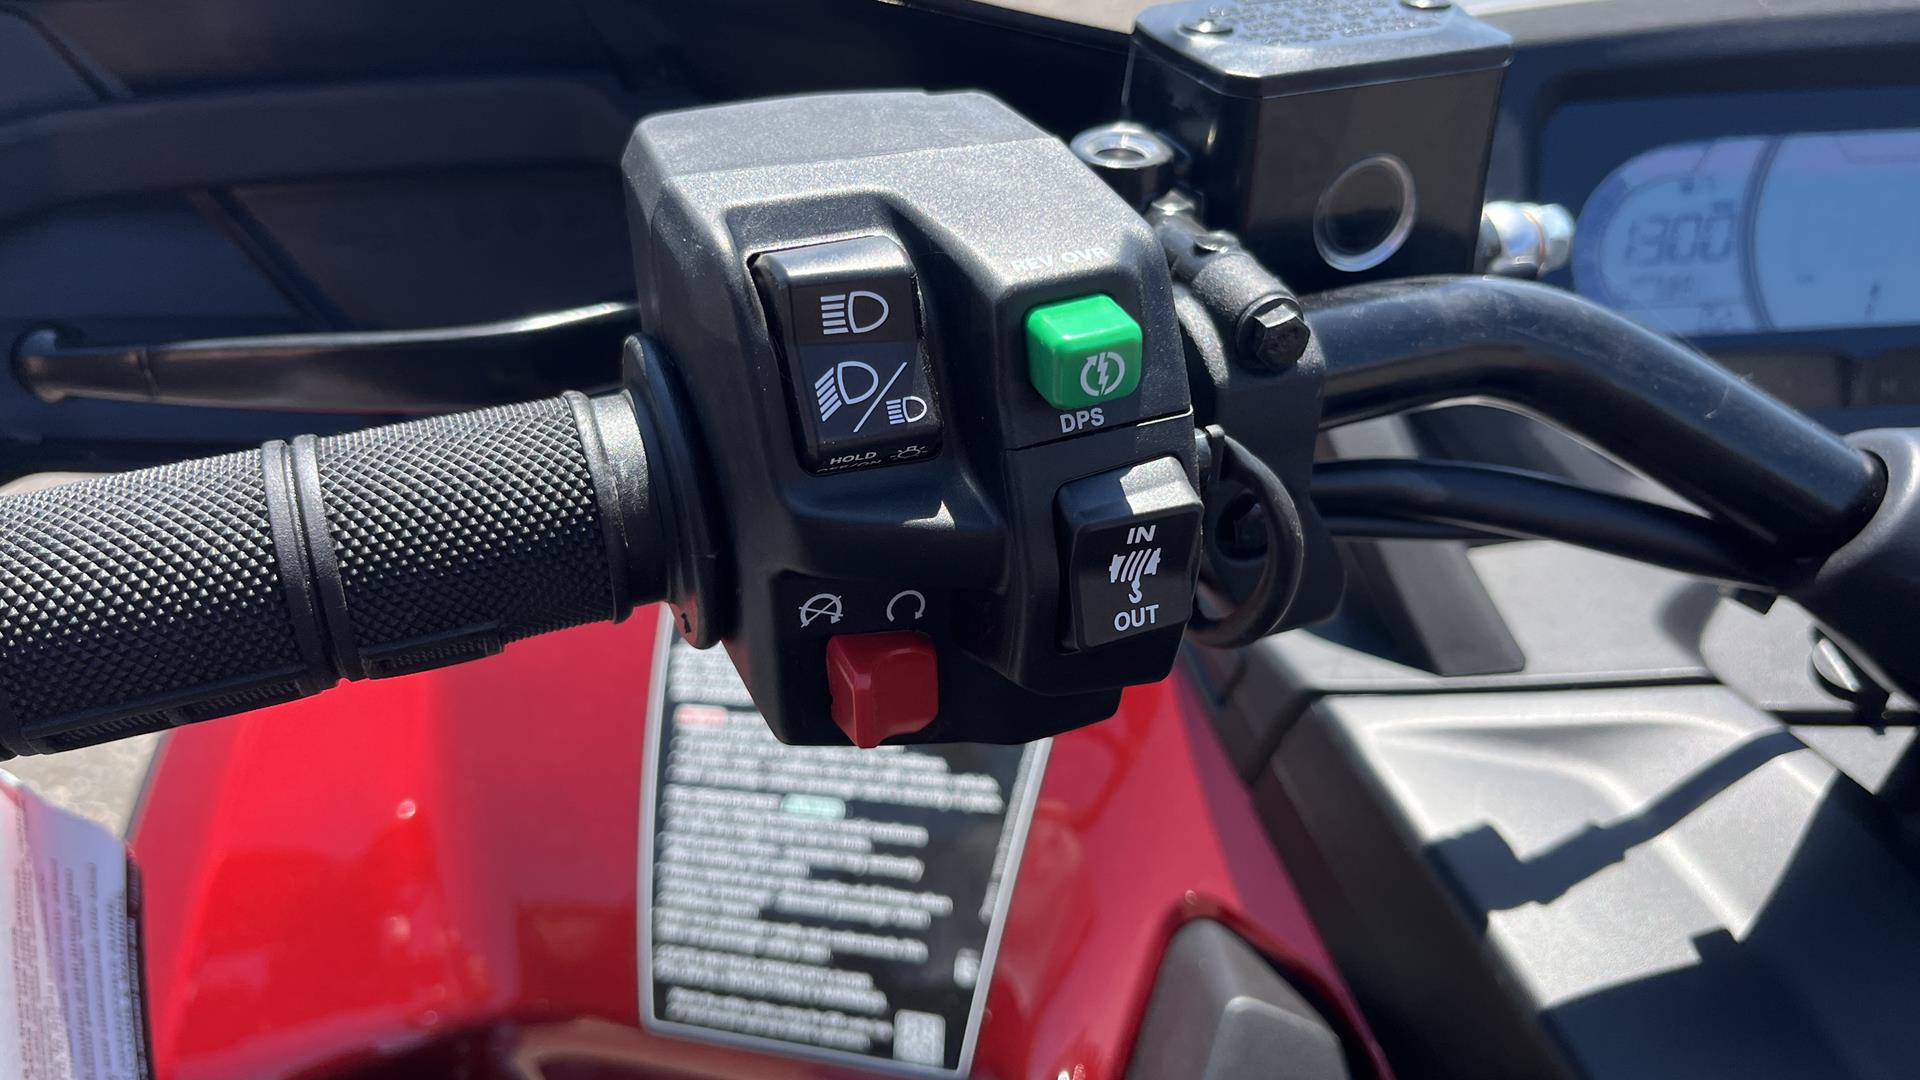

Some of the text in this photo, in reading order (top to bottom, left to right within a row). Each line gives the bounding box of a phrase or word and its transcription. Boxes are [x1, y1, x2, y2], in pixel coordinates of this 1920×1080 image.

[1060, 408, 1104, 433] DPS
[829, 452, 877, 465] HOLD
[1126, 525, 1156, 544] IN
[1114, 604, 1159, 631] OUT
